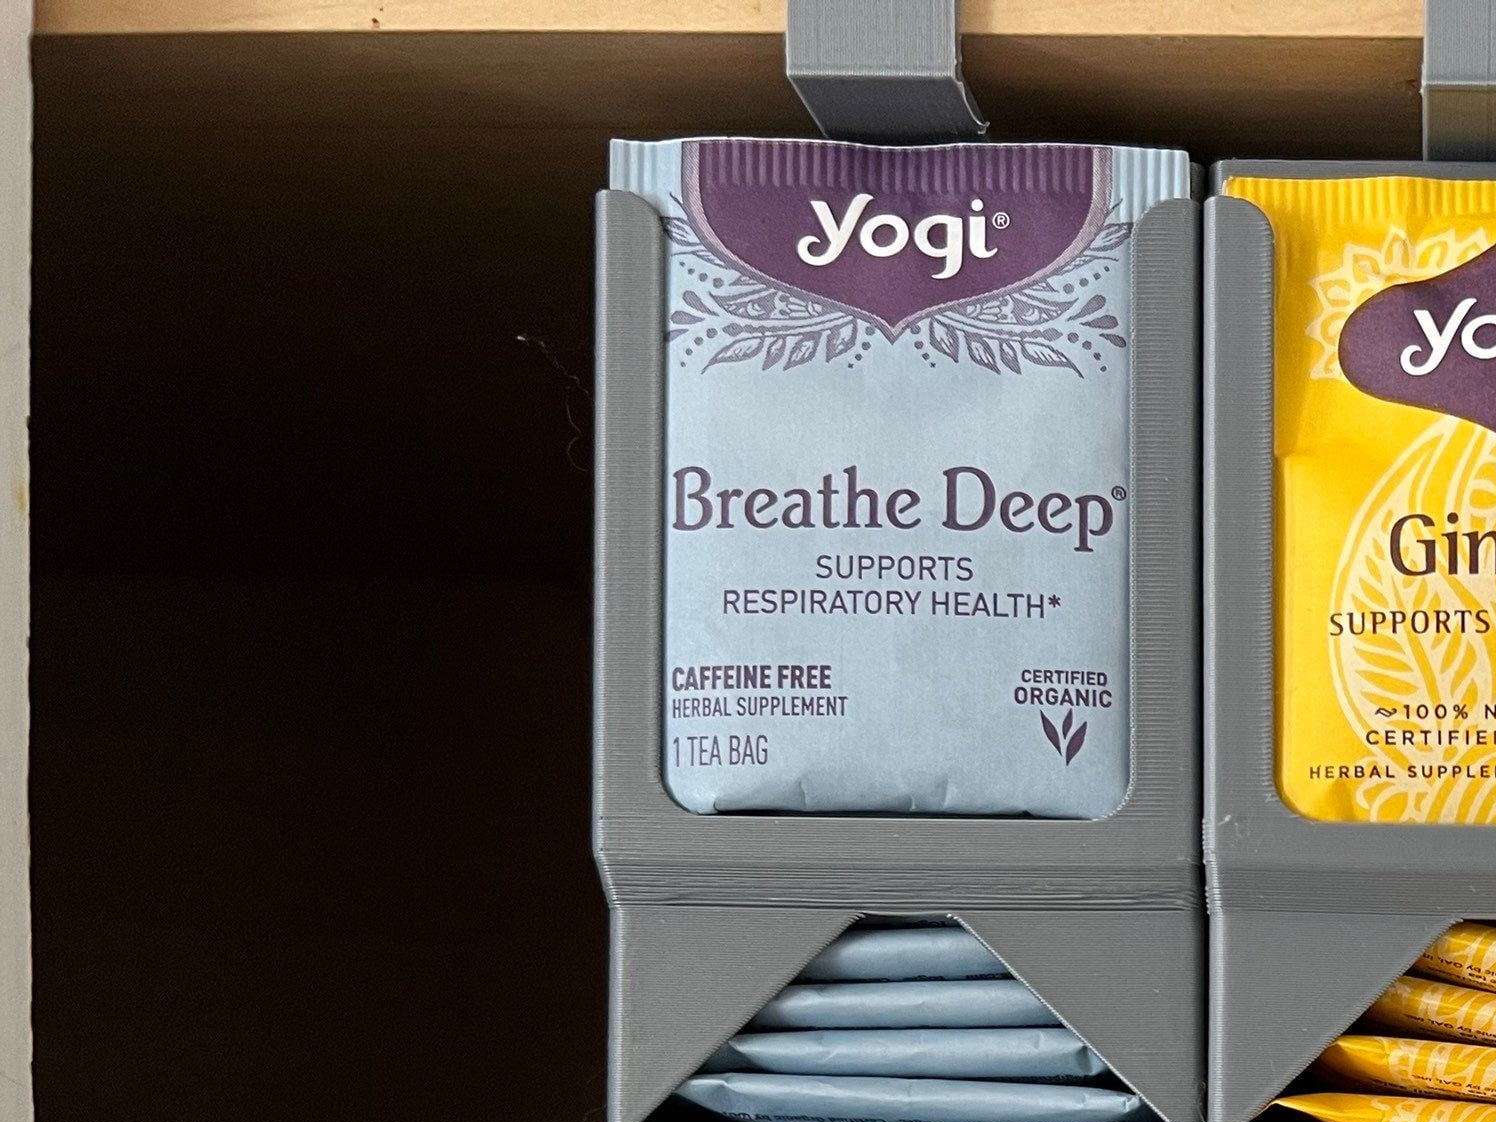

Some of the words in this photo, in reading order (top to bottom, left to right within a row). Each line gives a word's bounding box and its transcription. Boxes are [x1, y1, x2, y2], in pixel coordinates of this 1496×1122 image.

[672, 465, 920, 531] Breathe
[816, 555, 973, 582] SUPPORTS
[722, 590, 921, 616] RESPIRATORY
[1329, 610, 1490, 636] SUPPORTS
[672, 665, 771, 691] CAFFEINE
[777, 664, 831, 689] FREE
[1021, 669, 1108, 687] CERTIFIED
[672, 697, 732, 719] HERBAL
[736, 696, 848, 718] SUPPLEMENT
[1014, 686, 1113, 708] ORGANIC
[1403, 705, 1469, 720] 100%
[672, 737, 681, 767] 1
[687, 736, 722, 766] TEA
[729, 735, 768, 765] BAG
[1309, 765, 1396, 780] HERBAL
